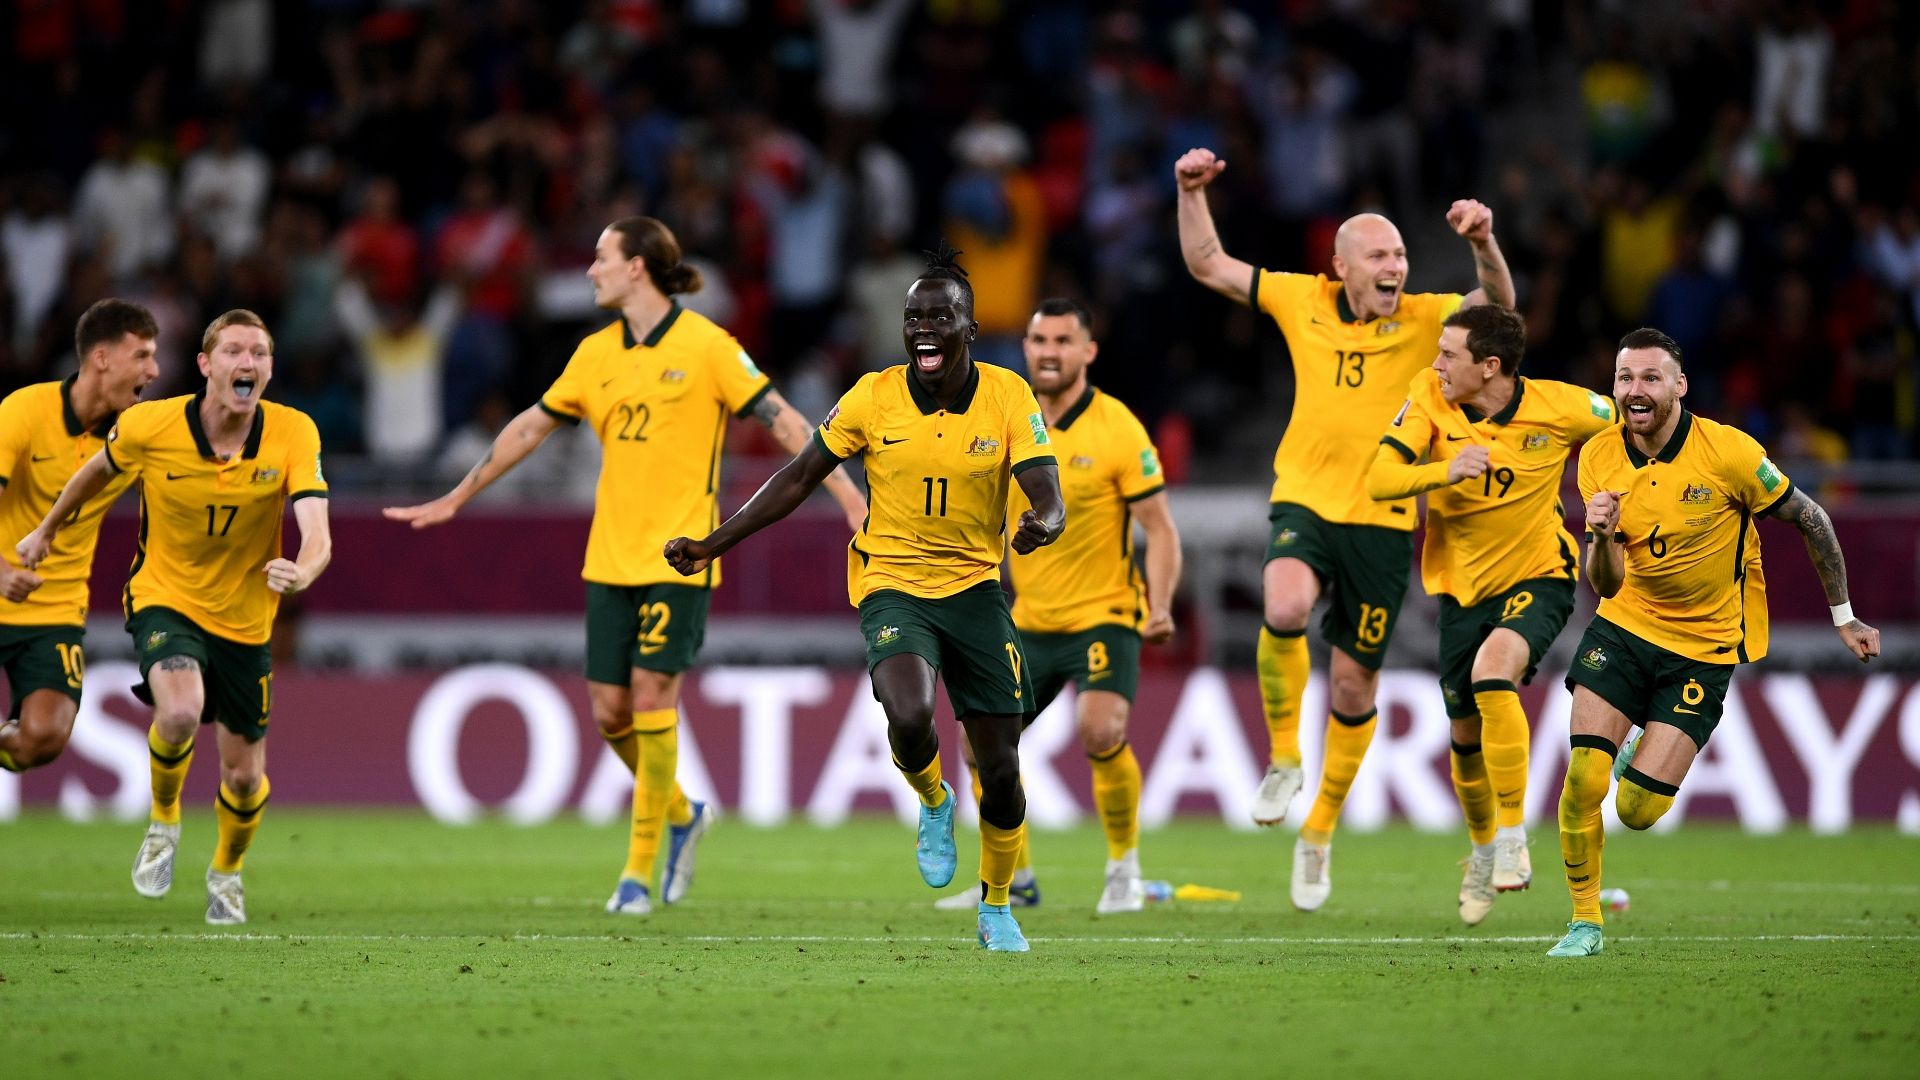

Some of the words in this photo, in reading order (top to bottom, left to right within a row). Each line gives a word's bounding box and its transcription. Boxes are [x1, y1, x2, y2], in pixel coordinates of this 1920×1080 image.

[1335, 350, 1365, 388] 13
[617, 403, 650, 442] 22
[922, 476, 948, 517] 11
[1483, 466, 1515, 499] 19
[205, 504, 239, 538] 17
[1647, 525, 1668, 560] 6
[638, 601, 671, 644] 22
[1358, 602, 1388, 644] 13
[1502, 591, 1533, 617] 19
[55, 642, 84, 682] 10
[1087, 641, 1109, 673] 8
